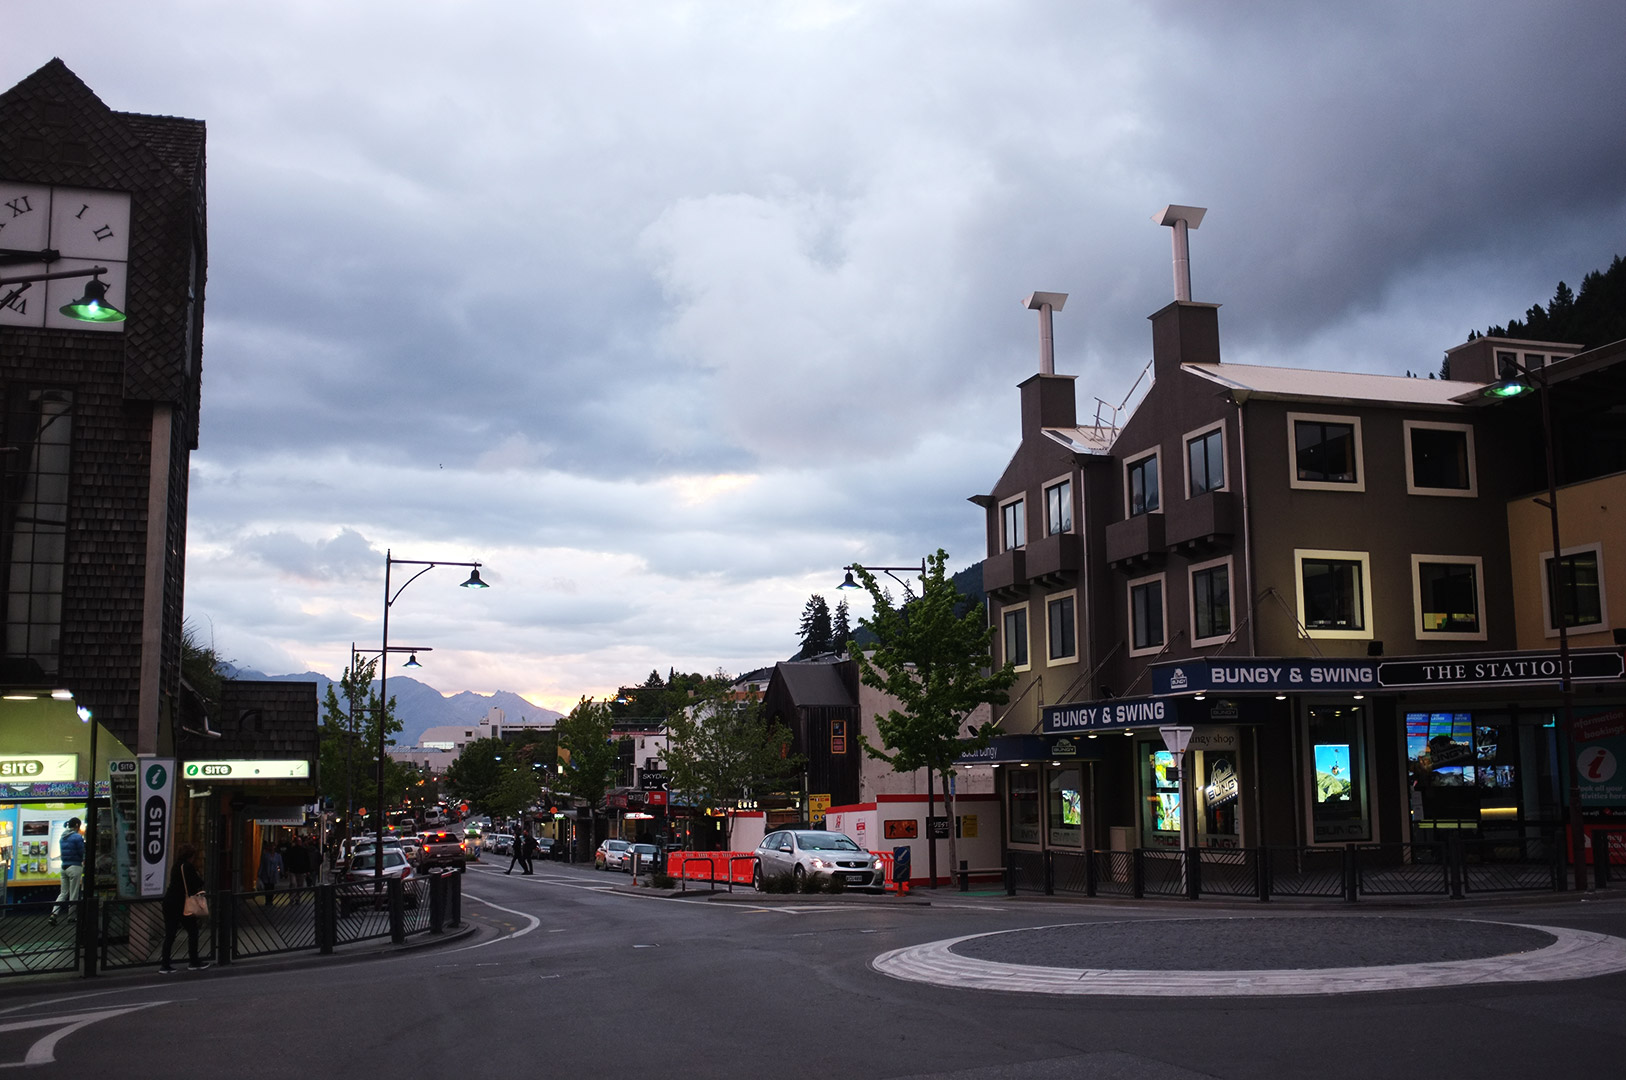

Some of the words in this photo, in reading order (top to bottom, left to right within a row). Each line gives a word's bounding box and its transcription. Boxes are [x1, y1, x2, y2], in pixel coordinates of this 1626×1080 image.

[75, 204, 89, 220] I
[93, 224, 114, 242] II
[1211, 668, 1282, 683] BUNGY
[1290, 668, 1303, 683] &
[1310, 668, 1373, 683] SWING
[1423, 665, 1467, 680] THE
[1053, 708, 1097, 728] BUNGY
[1102, 707, 1112, 724] &
[1116, 701, 1165, 723] SWING
[1574, 711, 1624, 728] nformation
[1189, 735, 1211, 746] ungy
[1213, 733, 1235, 746] shop
[1584, 725, 1625, 739] bookings
